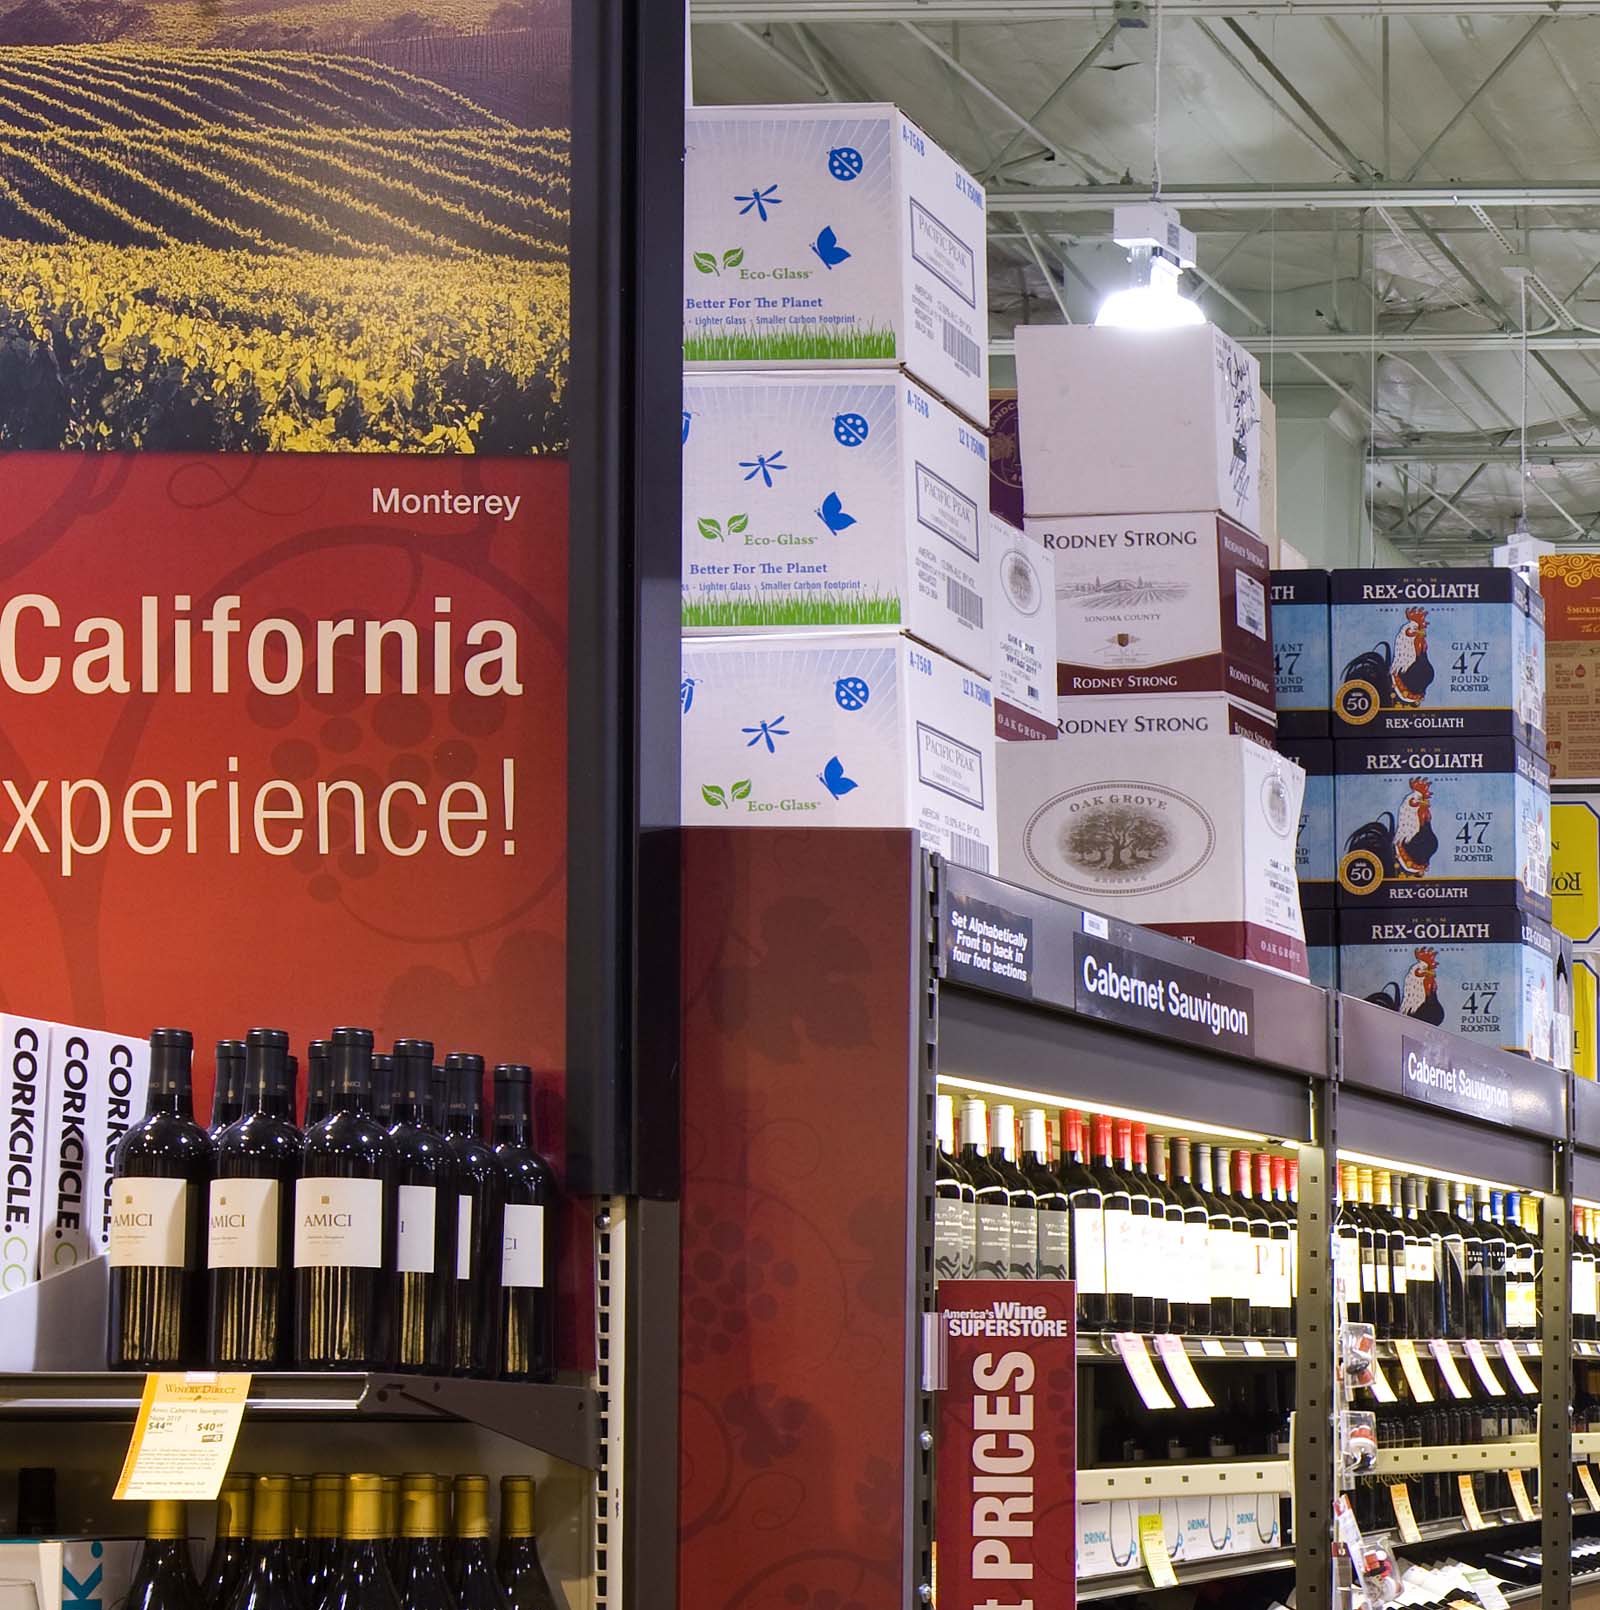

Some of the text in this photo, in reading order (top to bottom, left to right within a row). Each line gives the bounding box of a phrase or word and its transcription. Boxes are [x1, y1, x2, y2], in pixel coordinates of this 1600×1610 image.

[740, 268, 810, 280] Eco-Glass
[686, 297, 823, 309] Better For The Planet
[726, 316, 746, 325] Glass
[756, 315, 786, 324] Smaller
[371, 487, 521, 521] Monterey
[1043, 530, 1197, 552] RODNEY STRONG
[1363, 583, 1480, 599] REX-GOLIATH
[1084, 613, 1161, 624] SONOMA COUNTY
[1, 595, 523, 696] California
[1452, 642, 1489, 651] GIANT
[1452, 652, 1485, 674] 47
[1451, 684, 1490, 693] ROOSTER
[1452, 676, 1489, 684] POUND
[1346, 695, 1369, 711] 50
[748, 799, 816, 814] Eco-Glass
[1069, 794, 1167, 812] OAK GROVE
[951, 911, 1027, 951] Set Alphabetically
[957, 930, 1023, 964] Front to back in
[953, 946, 1027, 981] four foot sections
[1083, 954, 1248, 1037] Cabernet Sauvignon
[1408, 1052, 1509, 1110] Cabernet Sauvignon
[303, 1213, 353, 1228] AMICI
[943, 1302, 1047, 1320] America's Wine
[949, 1320, 1068, 1336] SUPERSTORE
[972, 1350, 1036, 1580] PRICES
